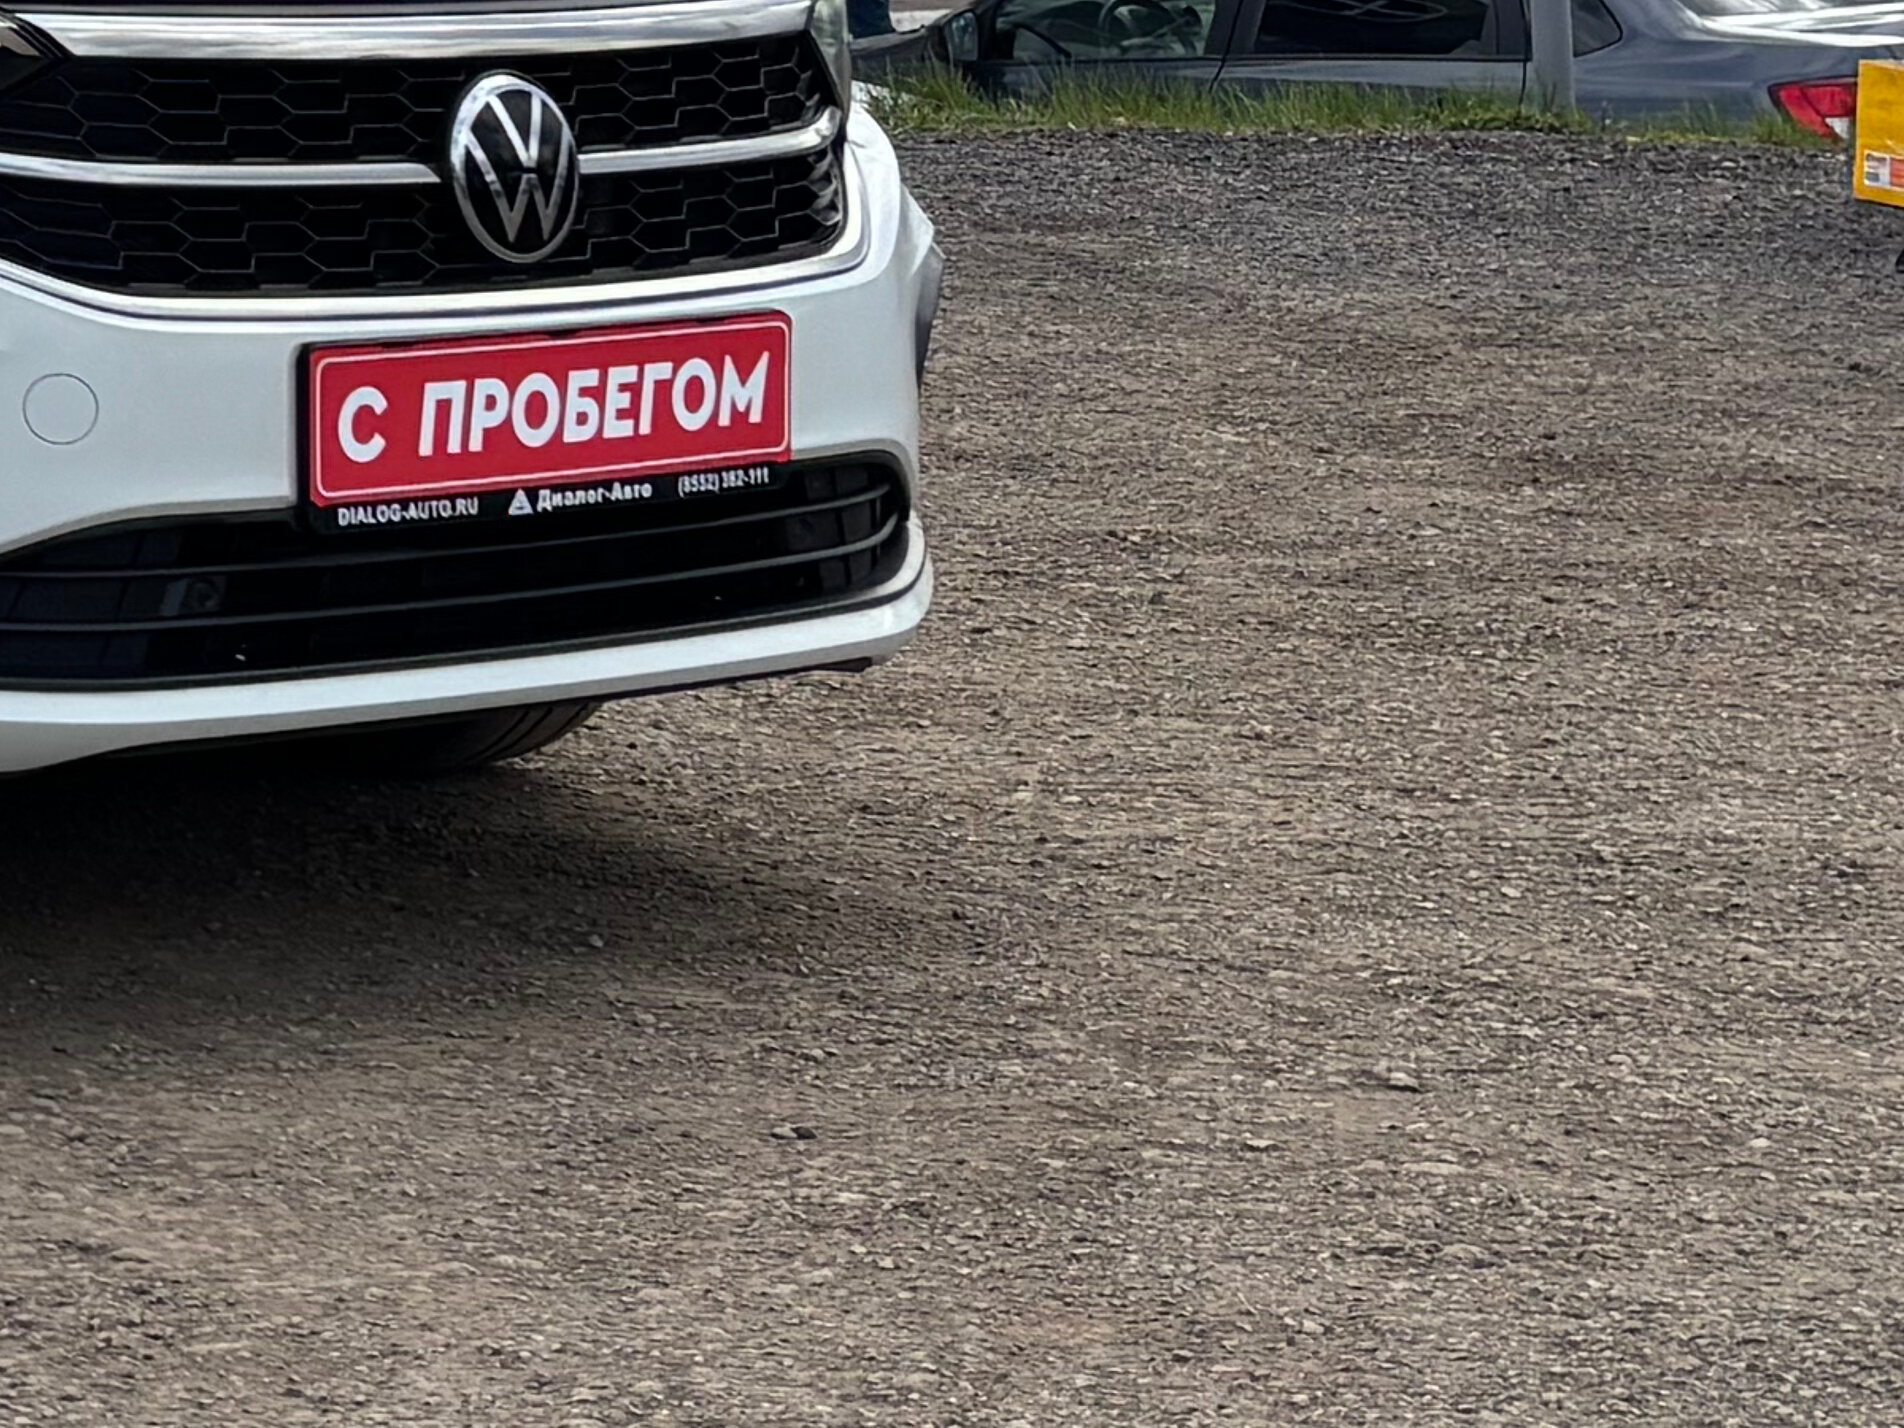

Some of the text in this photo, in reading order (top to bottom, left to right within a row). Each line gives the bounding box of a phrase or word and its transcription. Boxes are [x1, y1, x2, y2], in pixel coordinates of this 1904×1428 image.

[336, 350, 771, 464] С ПРОБЕГОМ
[337, 497, 479, 527] DIALOG-AUTO.RU
[536, 480, 653, 513] Диалог-Авто
